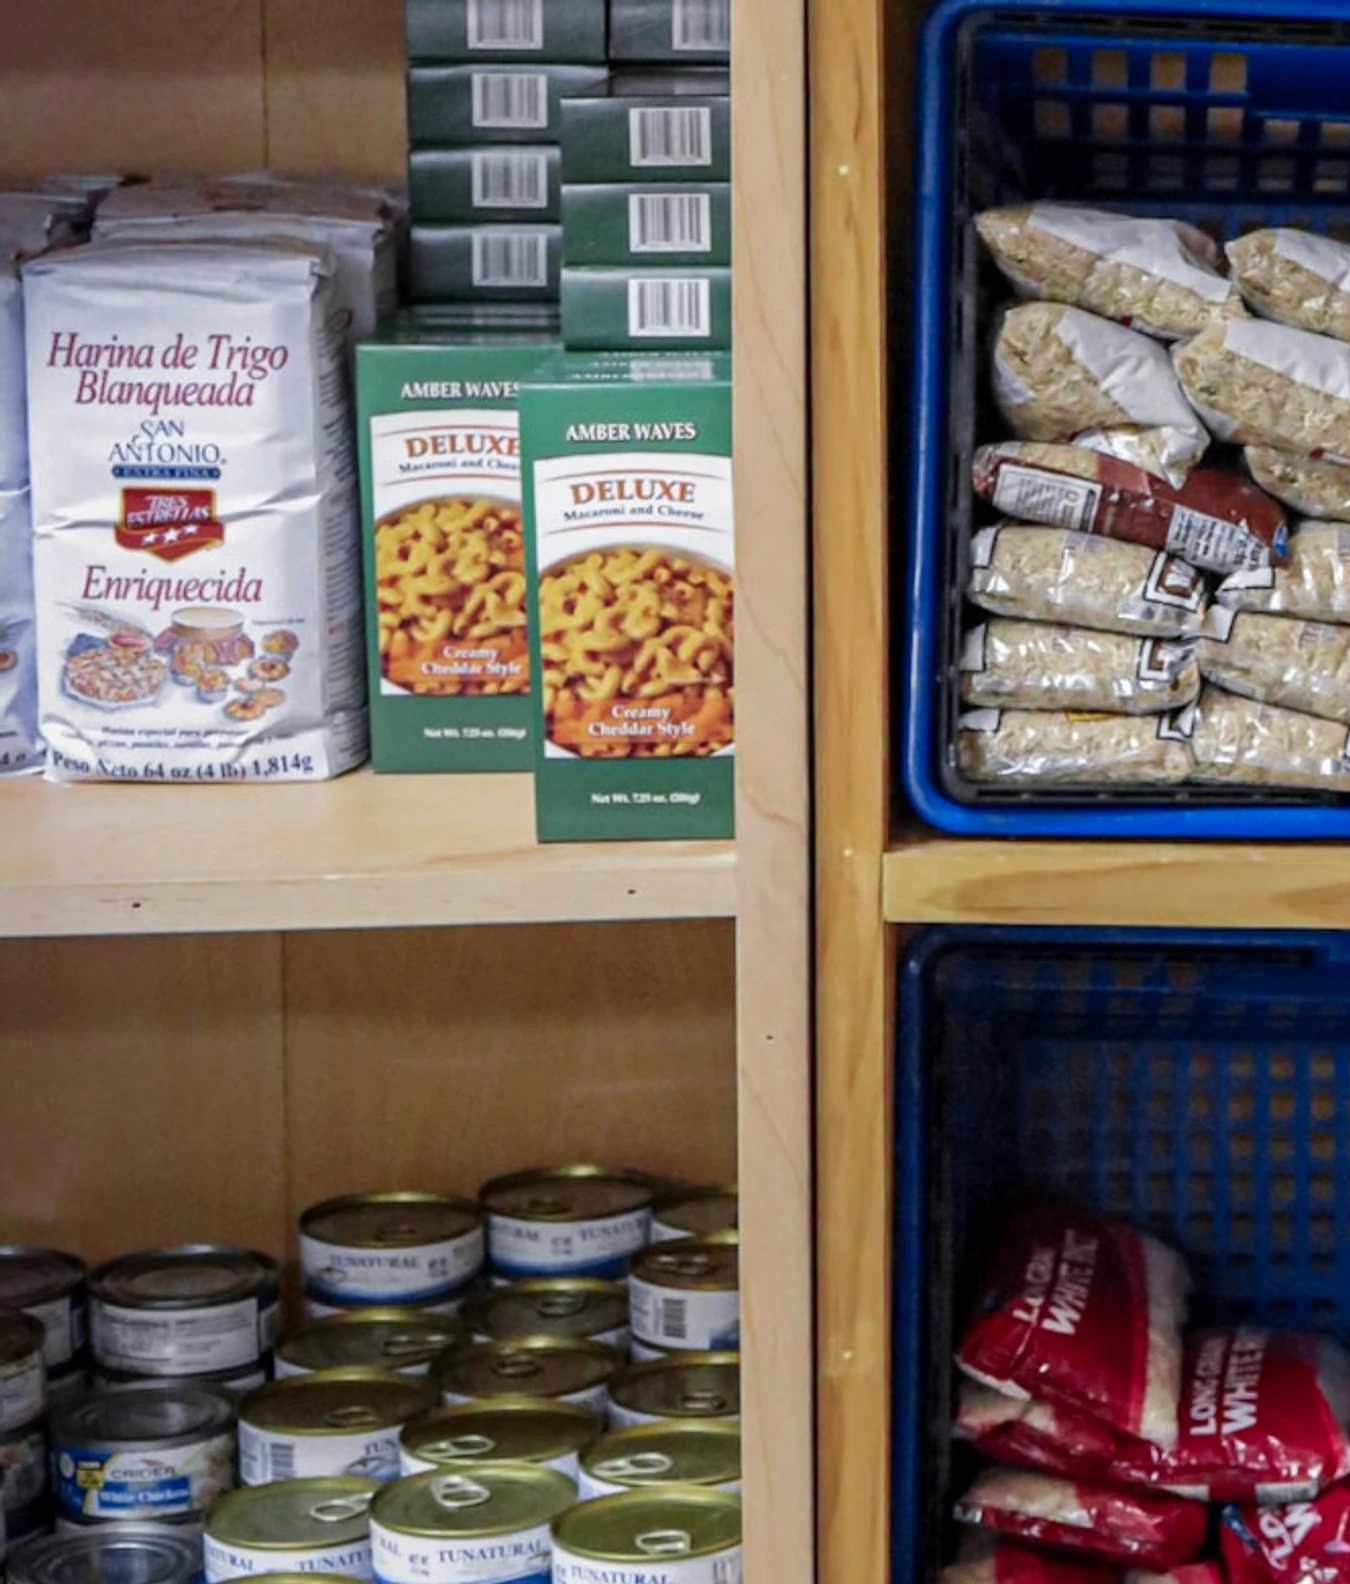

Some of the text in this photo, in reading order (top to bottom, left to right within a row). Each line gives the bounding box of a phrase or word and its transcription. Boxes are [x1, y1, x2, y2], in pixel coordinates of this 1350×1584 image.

[47, 332, 288, 380] Harina de Trigo
[75, 370, 254, 416] Blanqueada
[401, 381, 462, 398] AMBER
[133, 419, 184, 445] SAN
[566, 422, 697, 442] AMBER WAVES
[108, 442, 221, 464] ANTONIO
[398, 457, 456, 473] Macaroni
[461, 458, 482, 468] and
[569, 479, 697, 506] DELUXE
[564, 504, 704, 521] Macaroni and Cheese
[82, 565, 262, 610] Enriquecida
[443, 645, 498, 663] Creamy
[421, 661, 522, 678] Cheddar Style
[611, 704, 671, 722] Creamy
[587, 721, 696, 739] Cheddar Style
[53, 750, 90, 773] Peso
[143, 761, 166, 778] 64
[170, 765, 192, 779] oz
[195, 762, 215, 780] (4
[220, 759, 247, 780] lb)
[252, 753, 314, 777] 1,814g
[1221, 1352, 1264, 1436] WHITE
[437, 1538, 542, 1564] TUNATURAL
